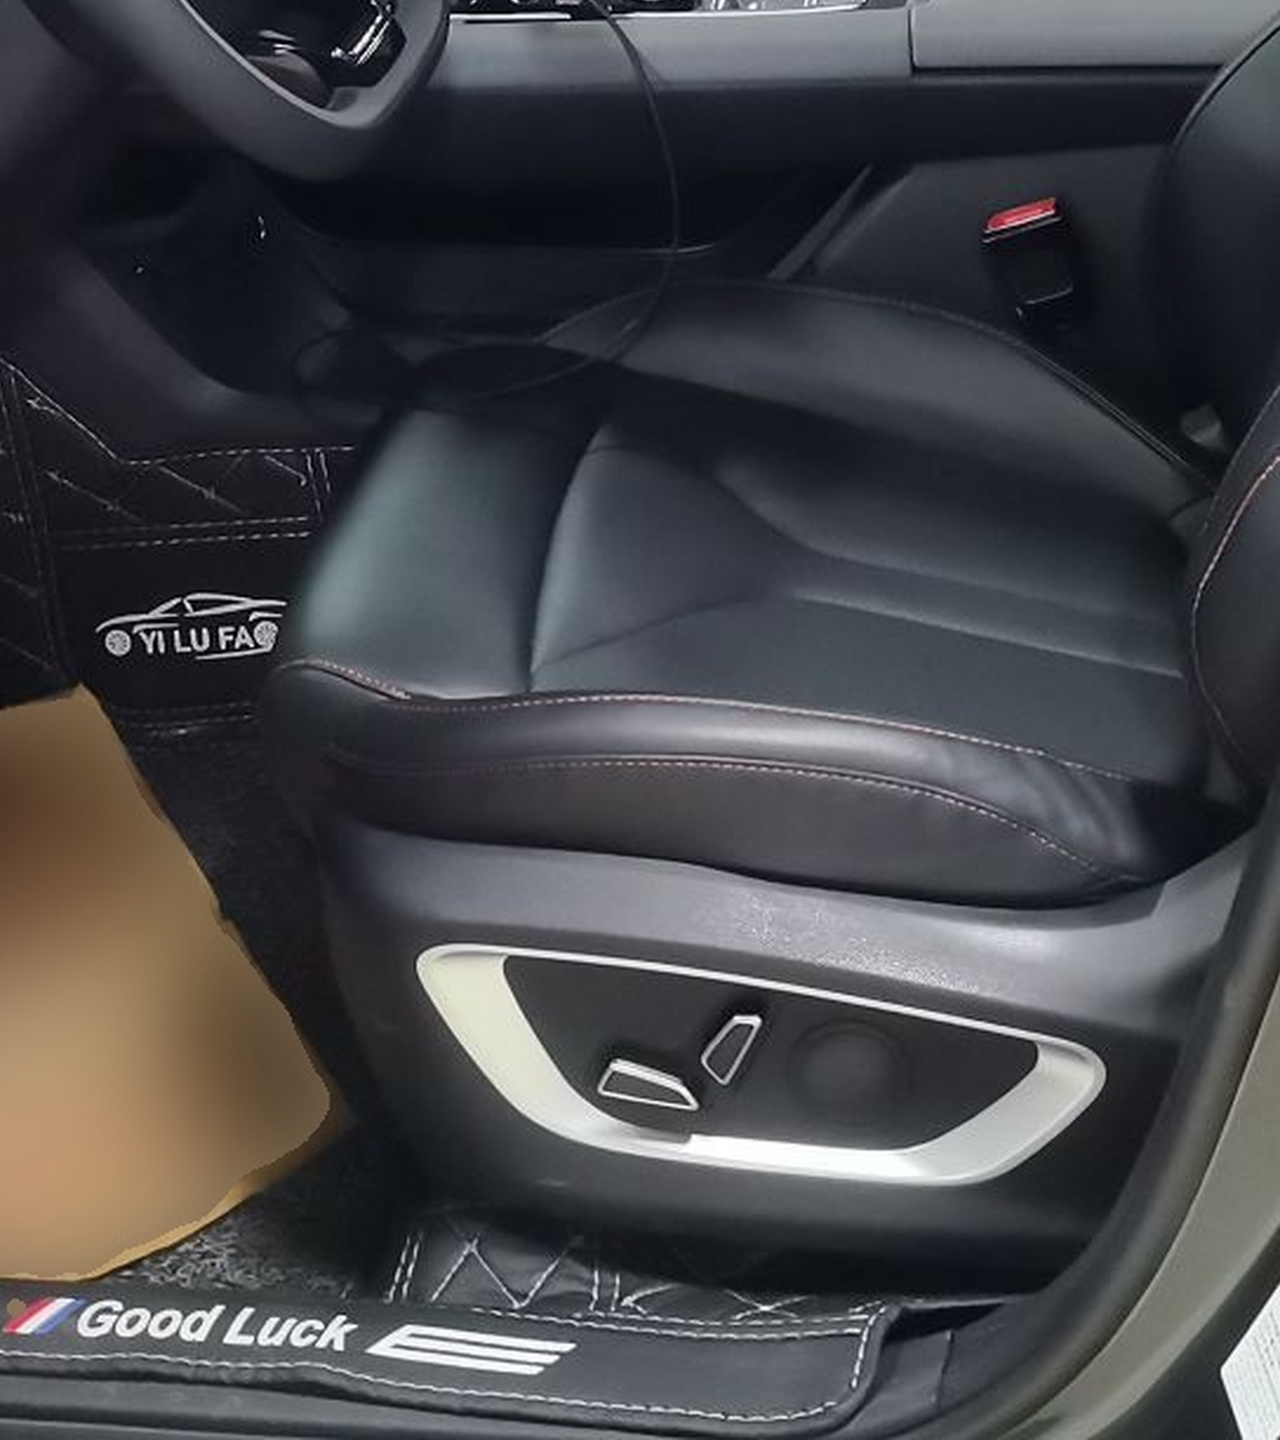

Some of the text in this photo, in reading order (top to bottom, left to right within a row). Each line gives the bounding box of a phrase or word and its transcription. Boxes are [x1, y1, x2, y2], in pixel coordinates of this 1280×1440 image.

[138, 630, 166, 654] YI
[173, 627, 210, 653] LU
[76, 1299, 359, 1351] Good Luck
